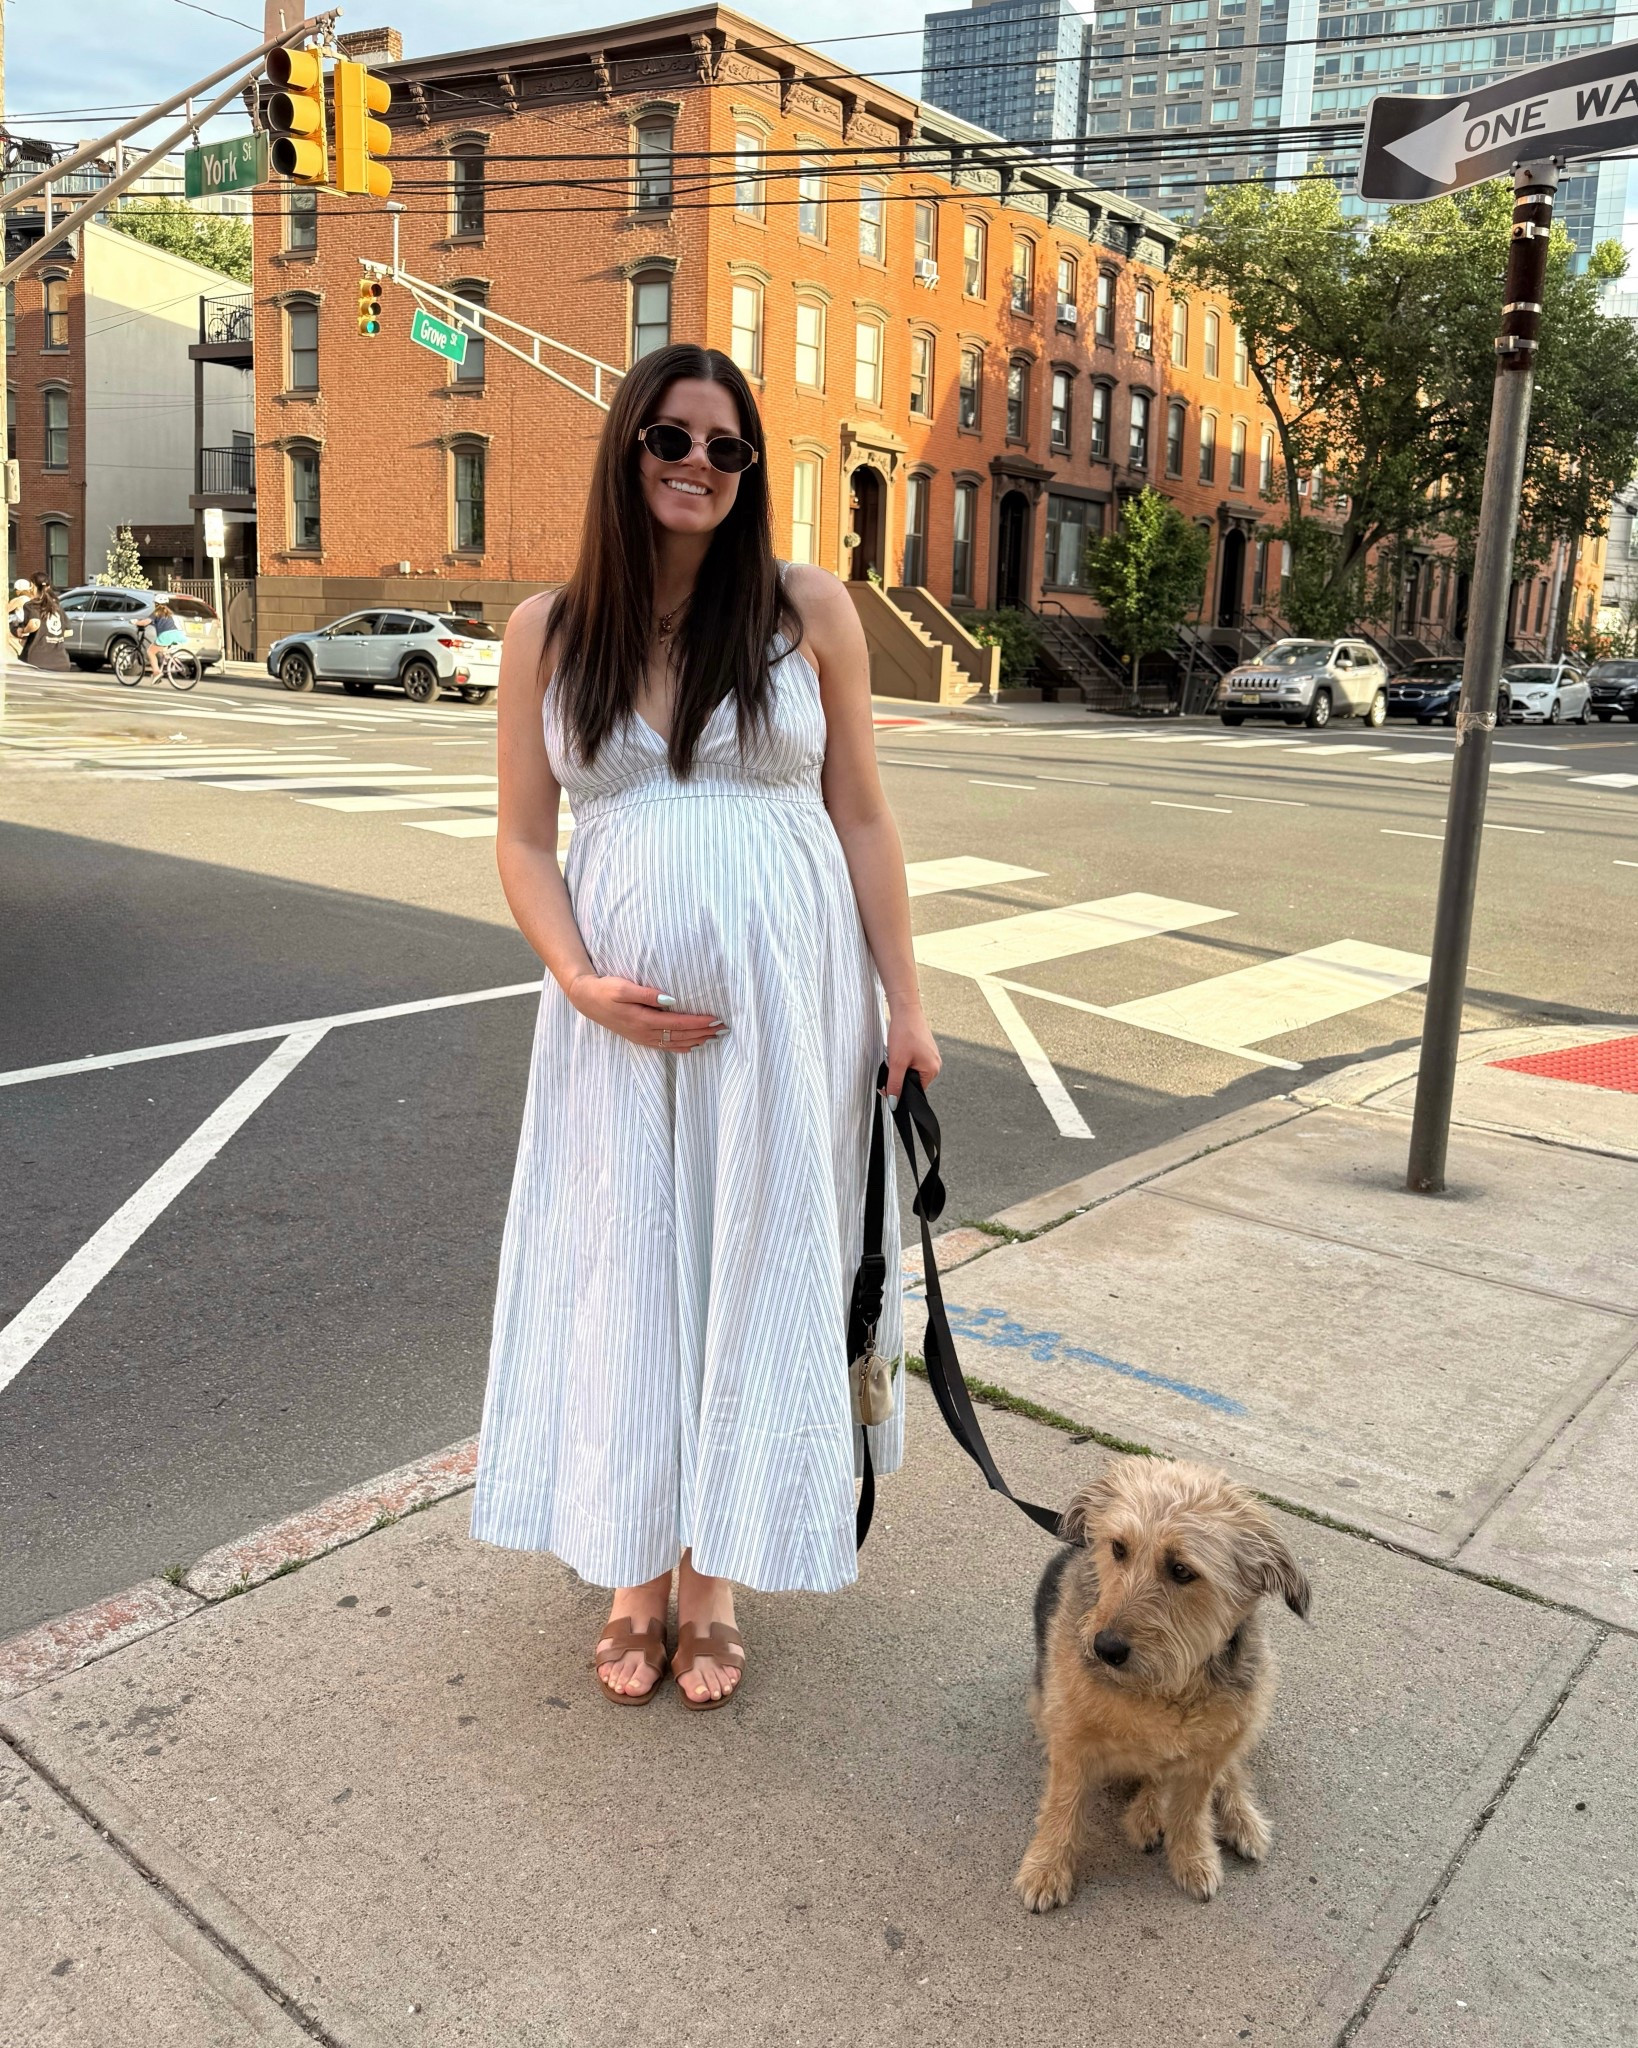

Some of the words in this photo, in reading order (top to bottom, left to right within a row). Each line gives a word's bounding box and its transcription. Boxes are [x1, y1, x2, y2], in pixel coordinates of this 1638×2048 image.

[1465, 98, 1549, 152] ONE
[1576, 78, 1638, 121] WA
[203, 150, 238, 186] York
[242, 141, 252, 162] St
[420, 319, 447, 350] Grove
[449, 333, 458, 347] St
